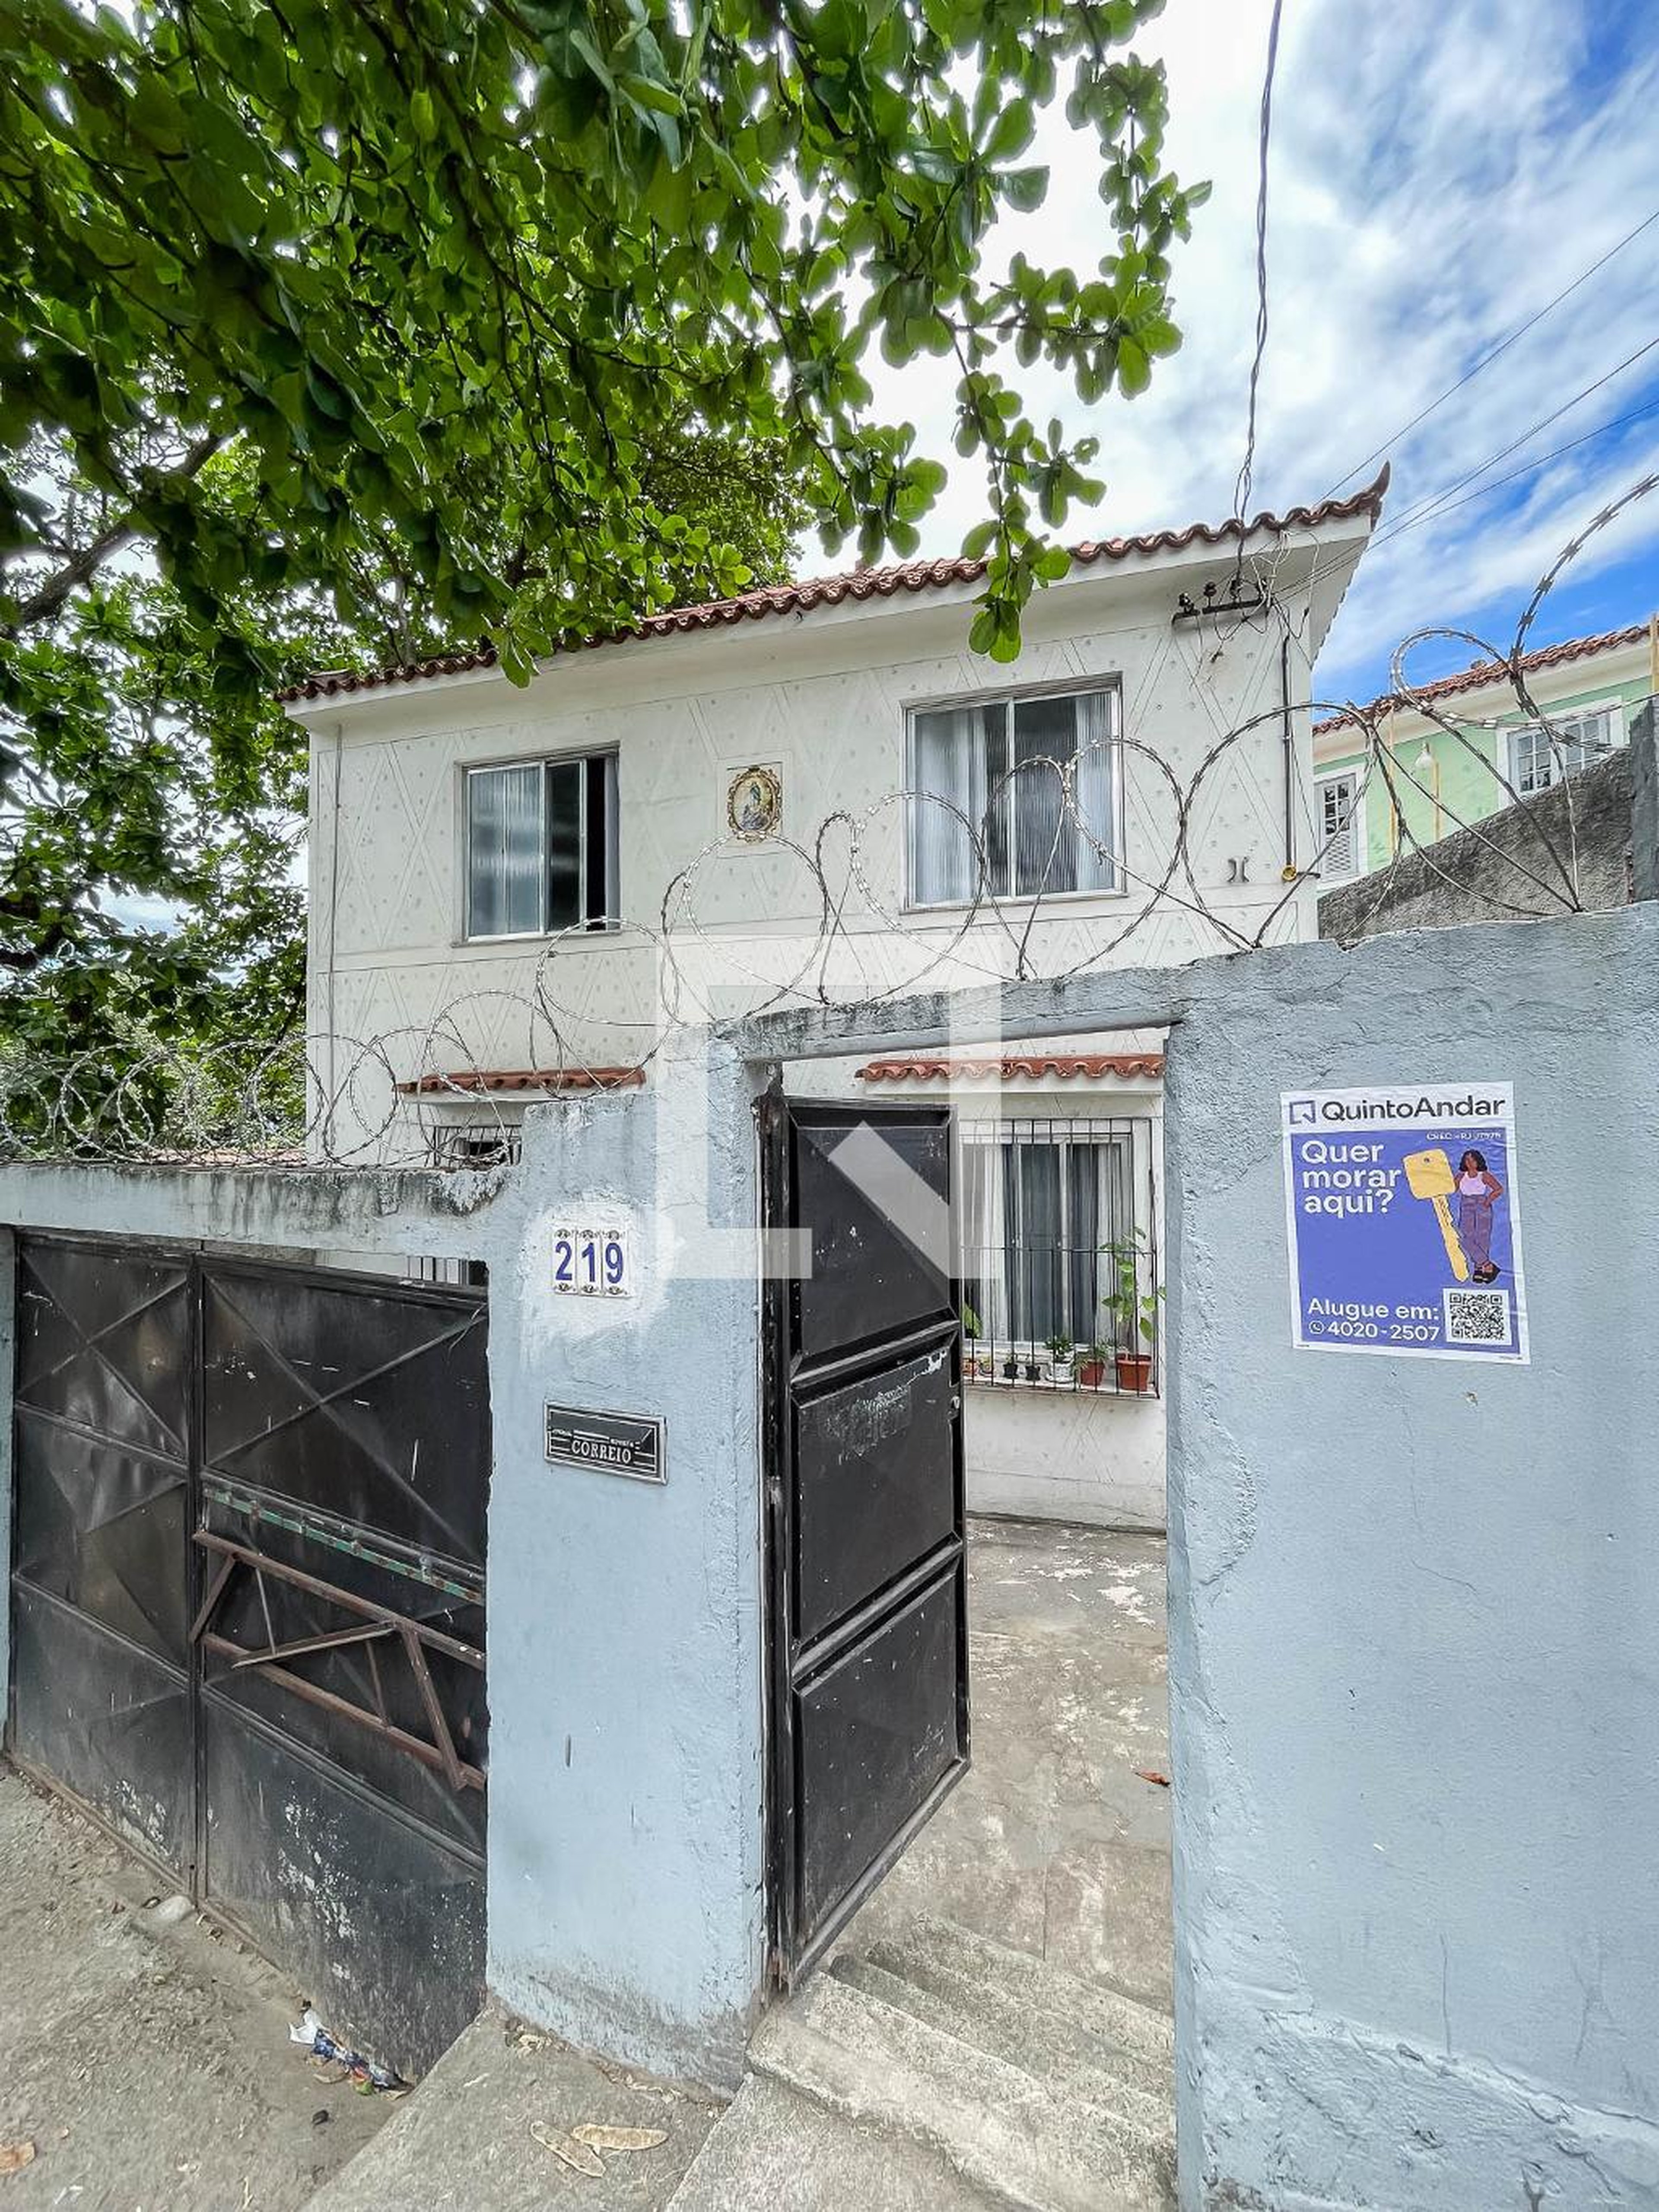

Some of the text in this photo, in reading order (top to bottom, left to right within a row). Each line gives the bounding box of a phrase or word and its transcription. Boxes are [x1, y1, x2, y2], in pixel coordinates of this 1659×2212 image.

[1321, 1095, 1506, 1121] QuintoAndar
[1301, 1140, 1384, 1164] Quer
[1302, 1168, 1402, 1189] morar
[1304, 1189, 1395, 1219] aqui?
[555, 1241, 624, 1284] 219
[1308, 1298, 1440, 1321] Alugue em:
[571, 1439, 632, 1464] CORREIO
